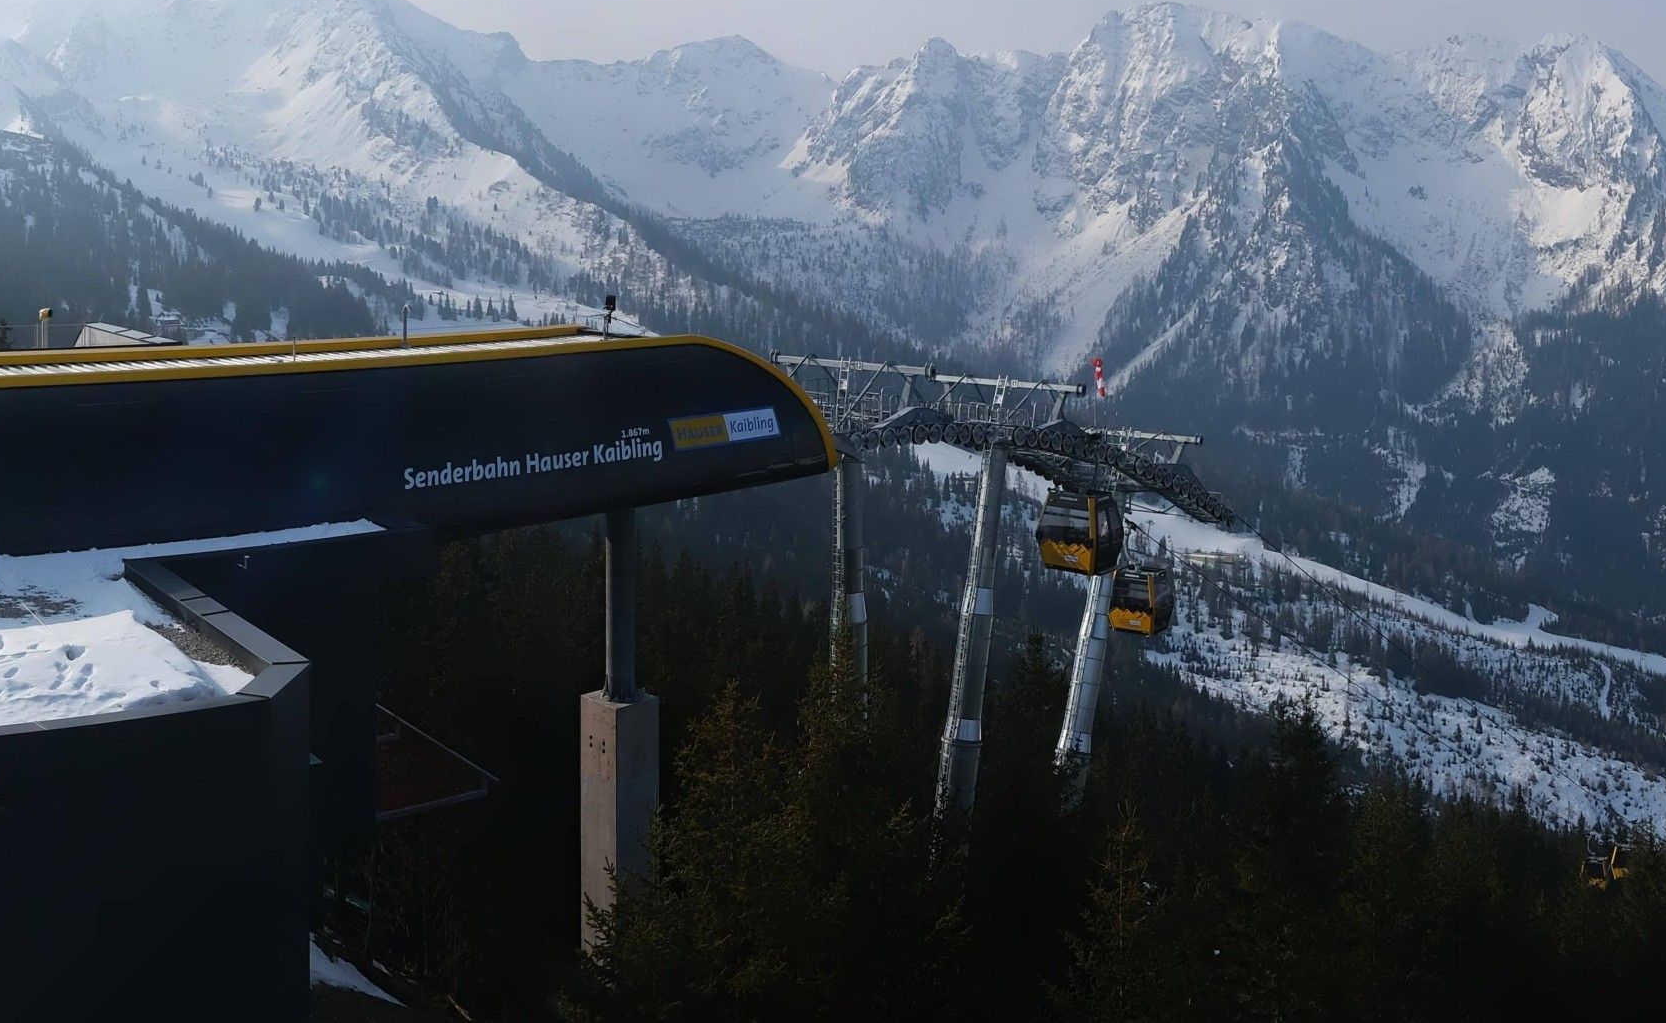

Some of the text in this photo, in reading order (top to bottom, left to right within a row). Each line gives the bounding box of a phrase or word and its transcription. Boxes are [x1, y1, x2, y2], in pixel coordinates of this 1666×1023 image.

[621, 427, 650, 439] 1.867m
[676, 417, 774, 441] HAUSER Kaibling
[404, 438, 662, 489] Senderbahn Hauser Kaibling
